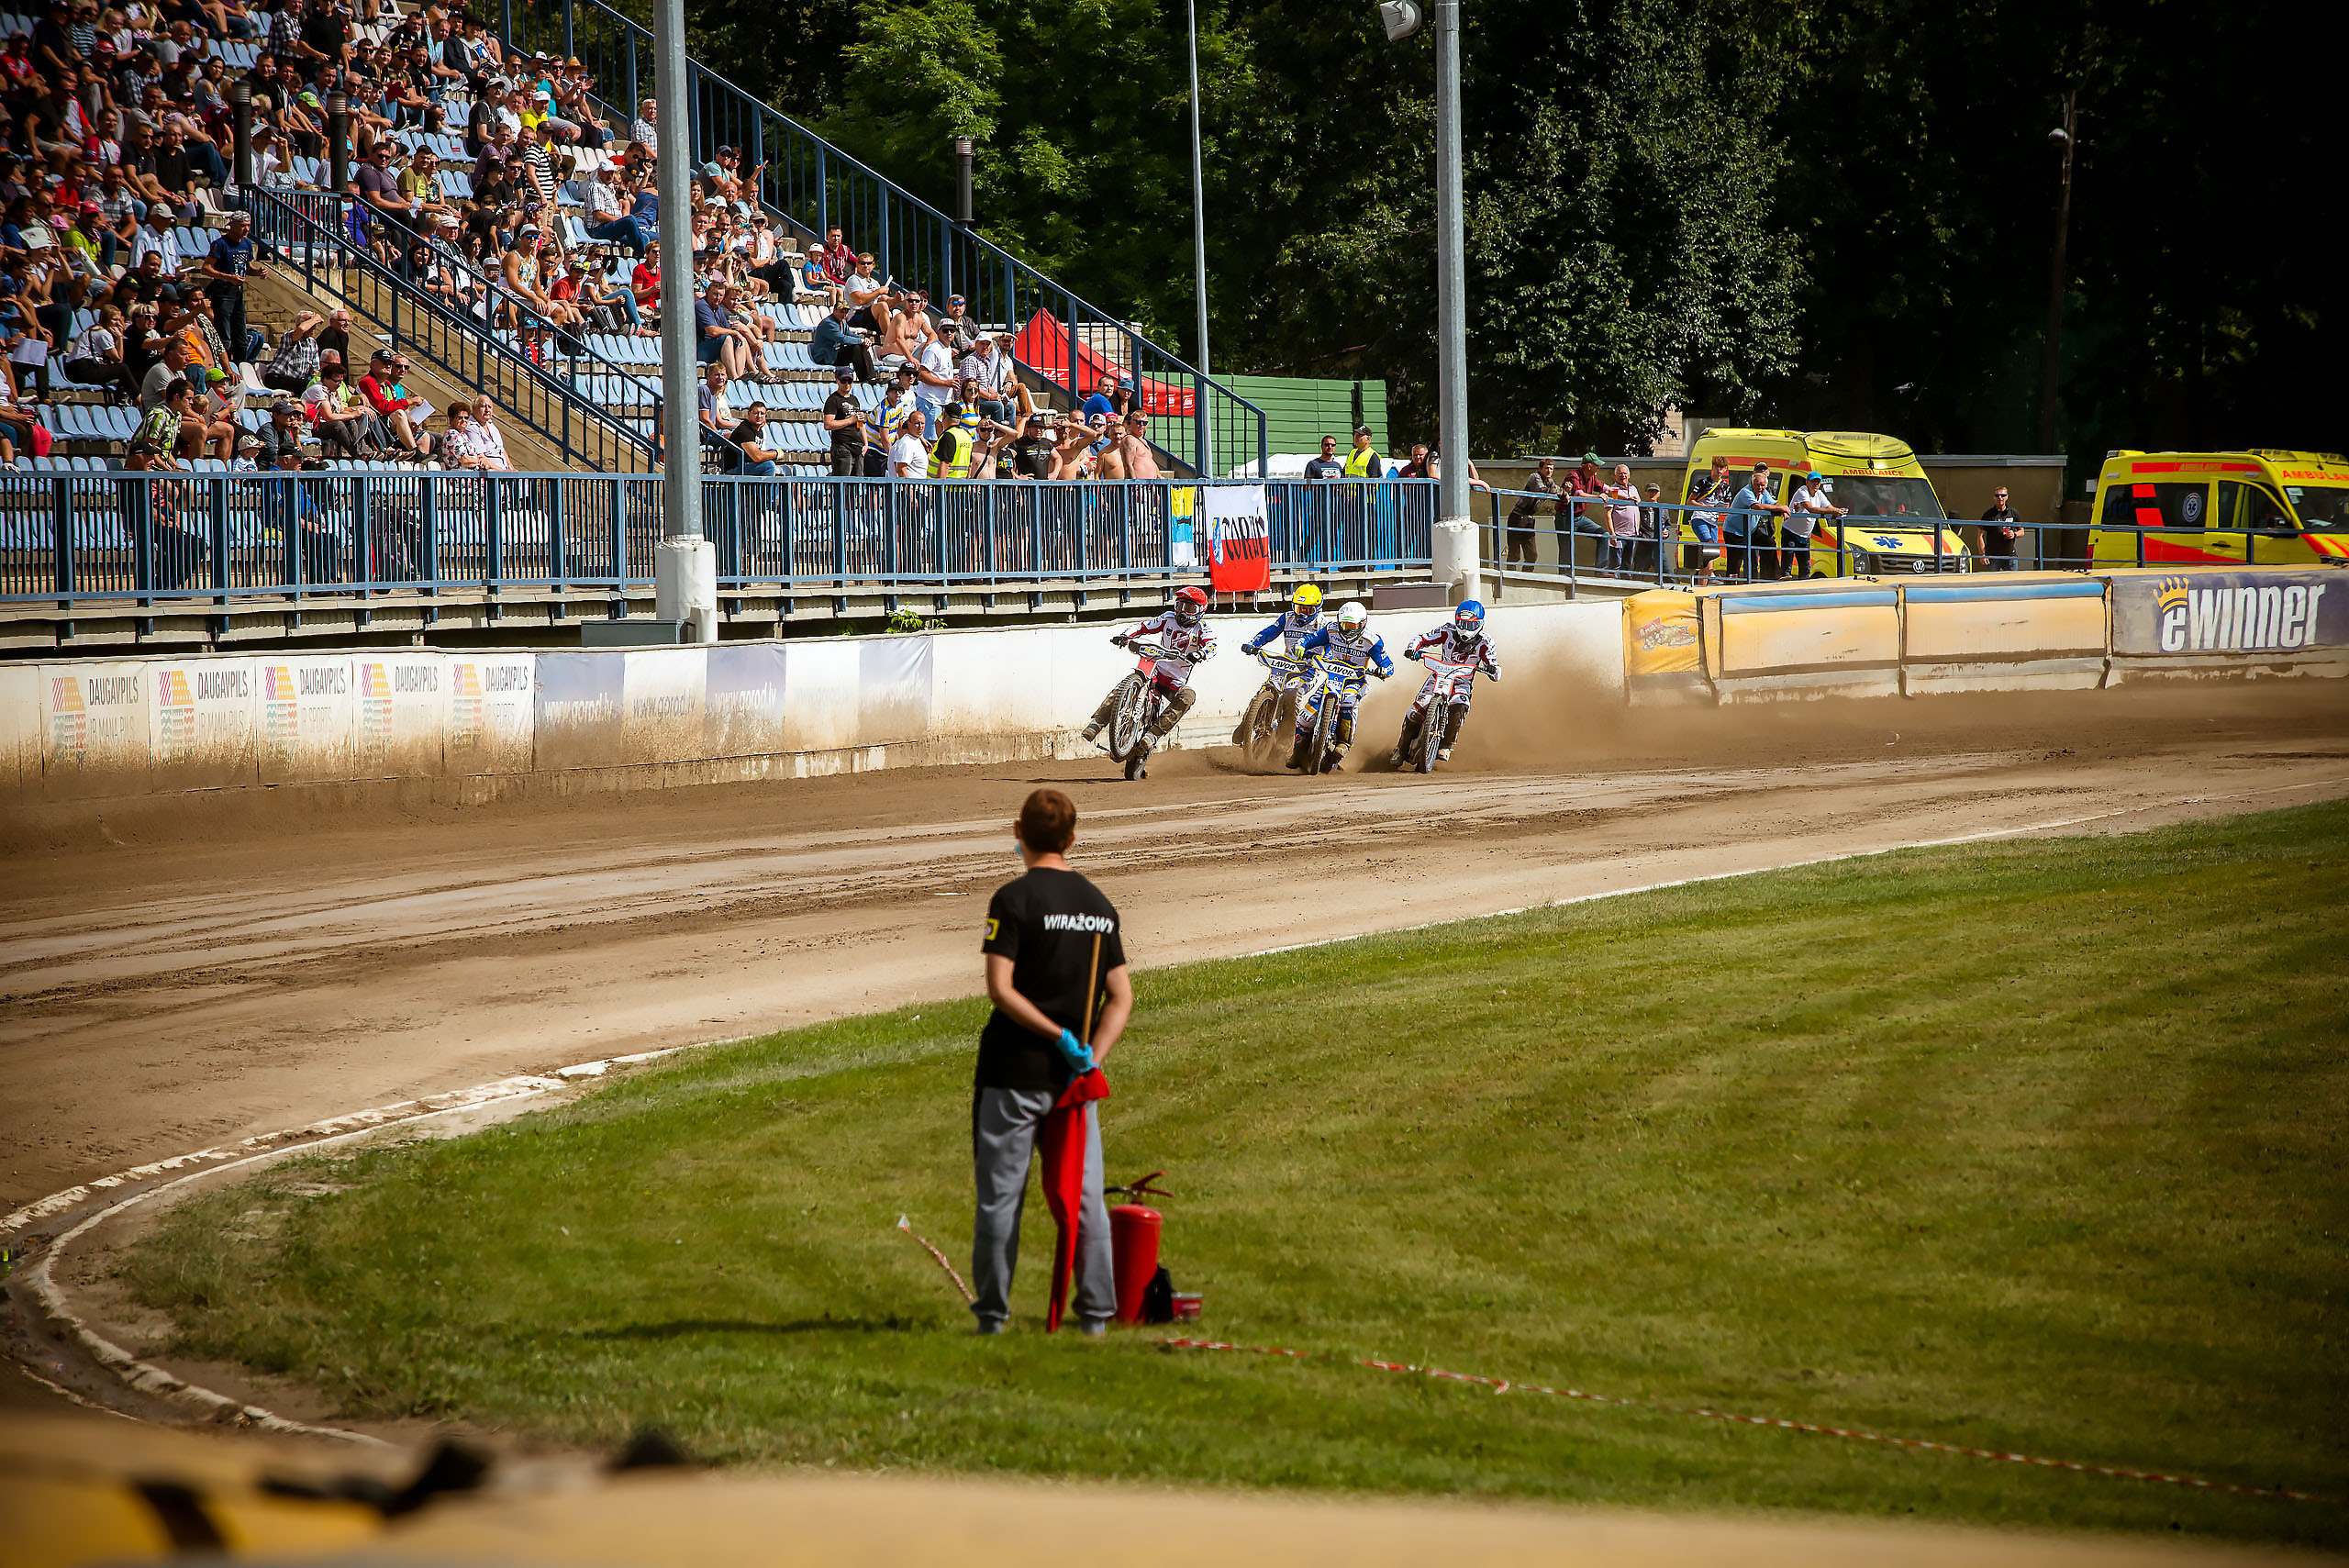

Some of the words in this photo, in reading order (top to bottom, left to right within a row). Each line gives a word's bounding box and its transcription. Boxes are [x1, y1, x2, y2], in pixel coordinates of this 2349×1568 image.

[1842, 469, 1905, 477] AMBULANCE
[395, 665, 438, 693] DAUGAVPILS
[485, 665, 529, 692] DAUGAVPILS
[1270, 660, 1296, 671] LAVOR
[1327, 664, 1353, 677] LAVOR
[89, 676, 139, 706] DAUGAVPILS
[197, 670, 249, 700] DAUGAVPILS
[299, 667, 346, 695] DAUGAVPILS
[1043, 913, 1115, 935] WIRAŻOWY
